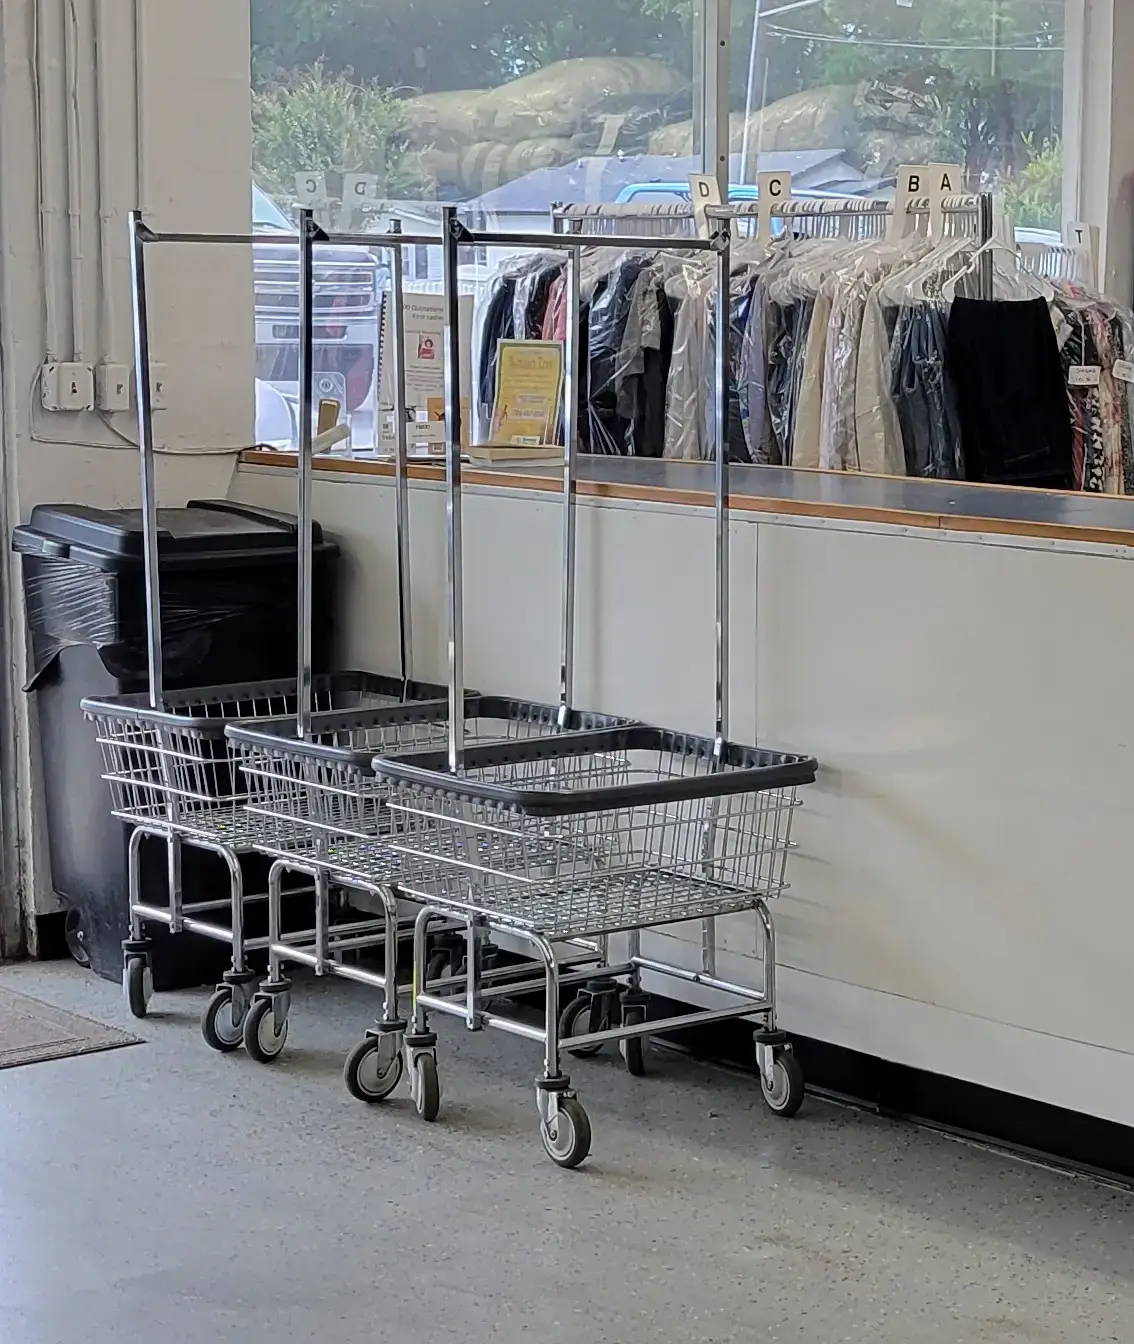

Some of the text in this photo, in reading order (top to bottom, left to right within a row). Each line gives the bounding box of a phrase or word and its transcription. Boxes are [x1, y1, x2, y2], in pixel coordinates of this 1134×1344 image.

[699, 182, 709, 197] D
[770, 179, 781, 196] C
[908, 175, 919, 192] B
[941, 174, 951, 191] A
[1075, 230, 1083, 243] T
